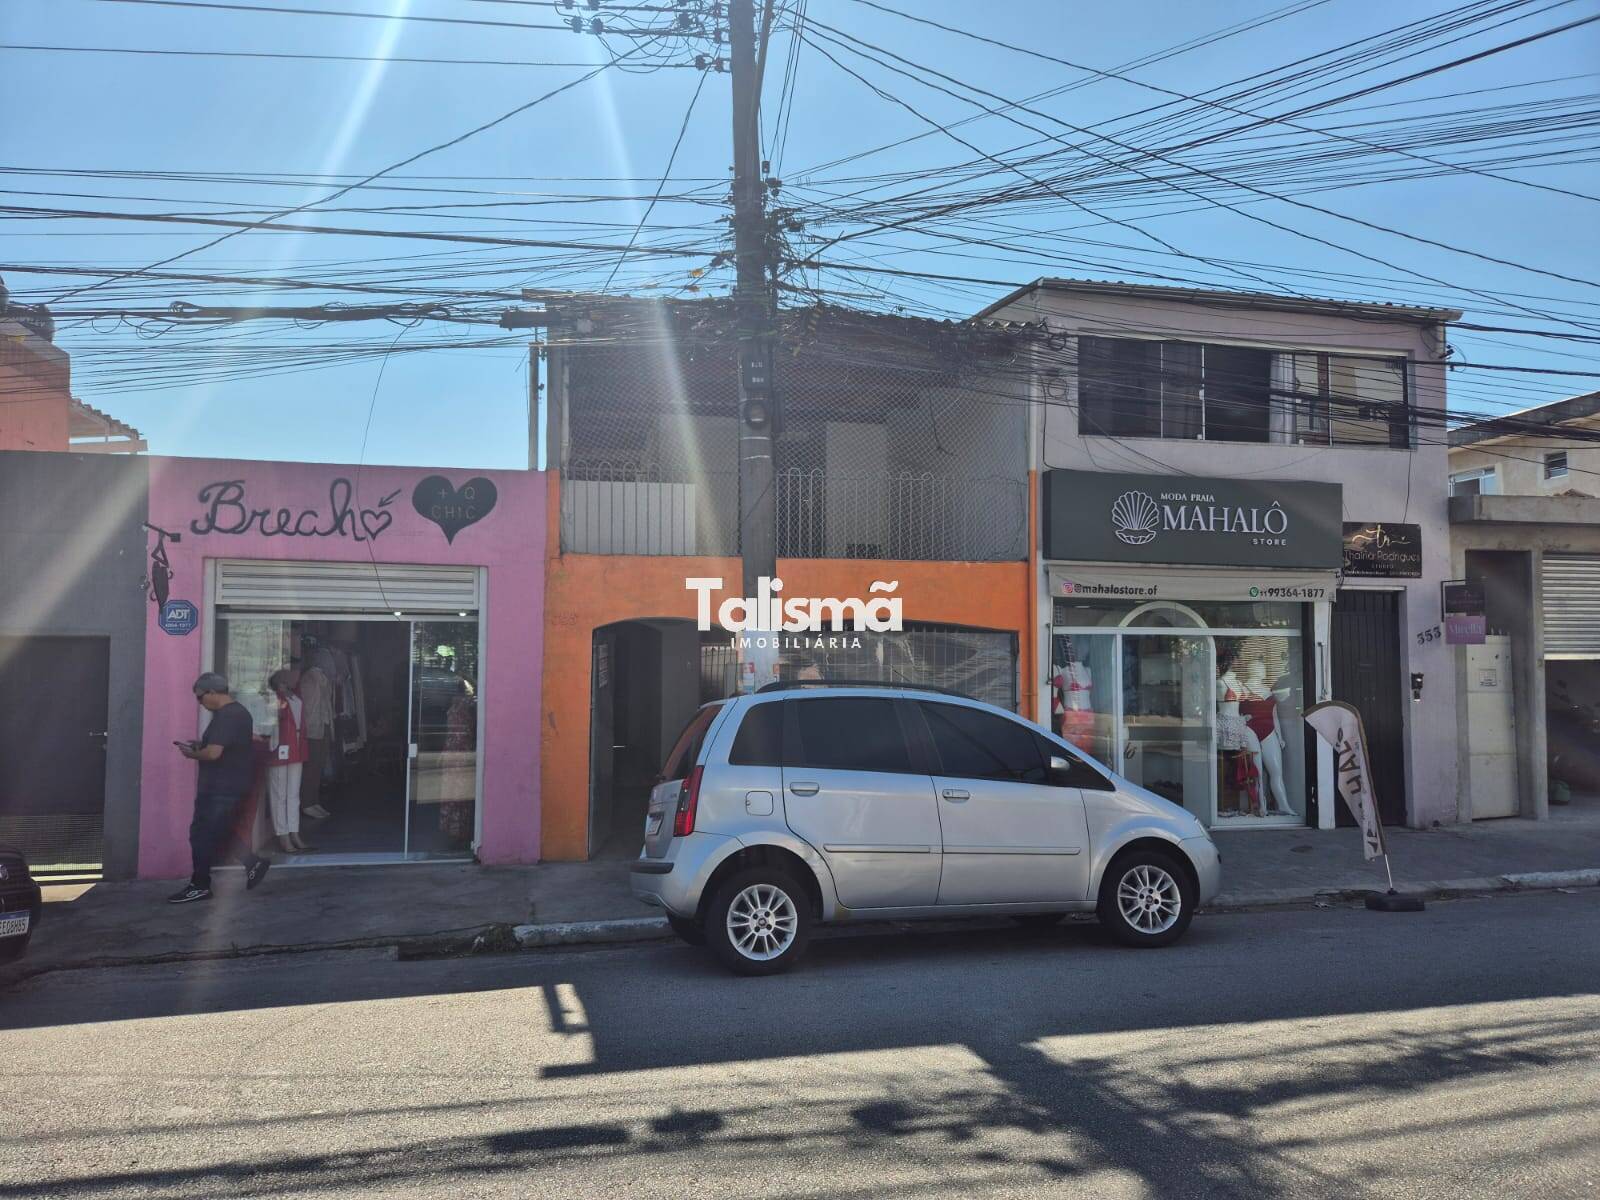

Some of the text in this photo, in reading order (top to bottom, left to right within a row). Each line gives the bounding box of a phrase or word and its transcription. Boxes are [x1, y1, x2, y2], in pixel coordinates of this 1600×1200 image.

[1160, 493, 1215, 503] MODA PRAIA
[432, 503, 476, 520] CHIC
[1162, 500, 1288, 535] MAHALÔ
[1252, 538, 1287, 546] STORE
[1074, 583, 1158, 595] @mahalostore.of
[1267, 587, 1325, 598] 99364-1877
[168, 609, 190, 620] ADT
